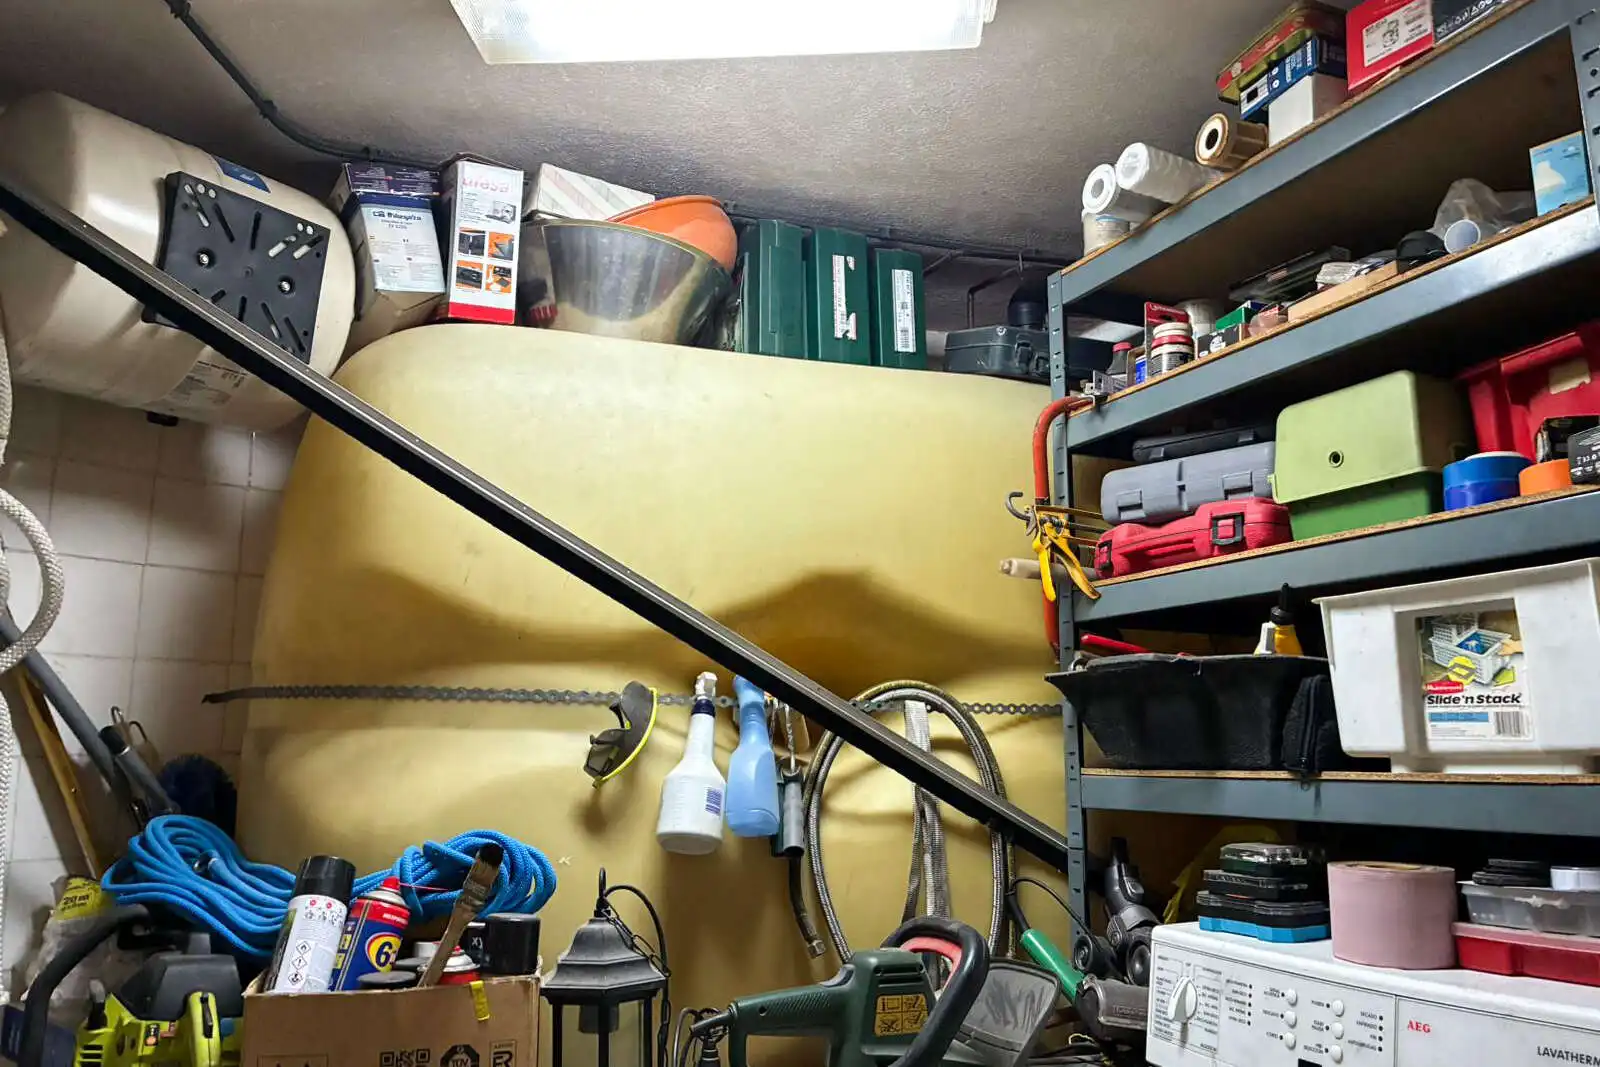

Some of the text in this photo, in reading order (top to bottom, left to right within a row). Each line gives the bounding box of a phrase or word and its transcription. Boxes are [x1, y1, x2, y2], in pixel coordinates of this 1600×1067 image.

[1427, 695, 1460, 705] Slide
[1476, 694, 1521, 704] Stack
[375, 941, 393, 968] 6
[1407, 1019, 1431, 1033] AEG
